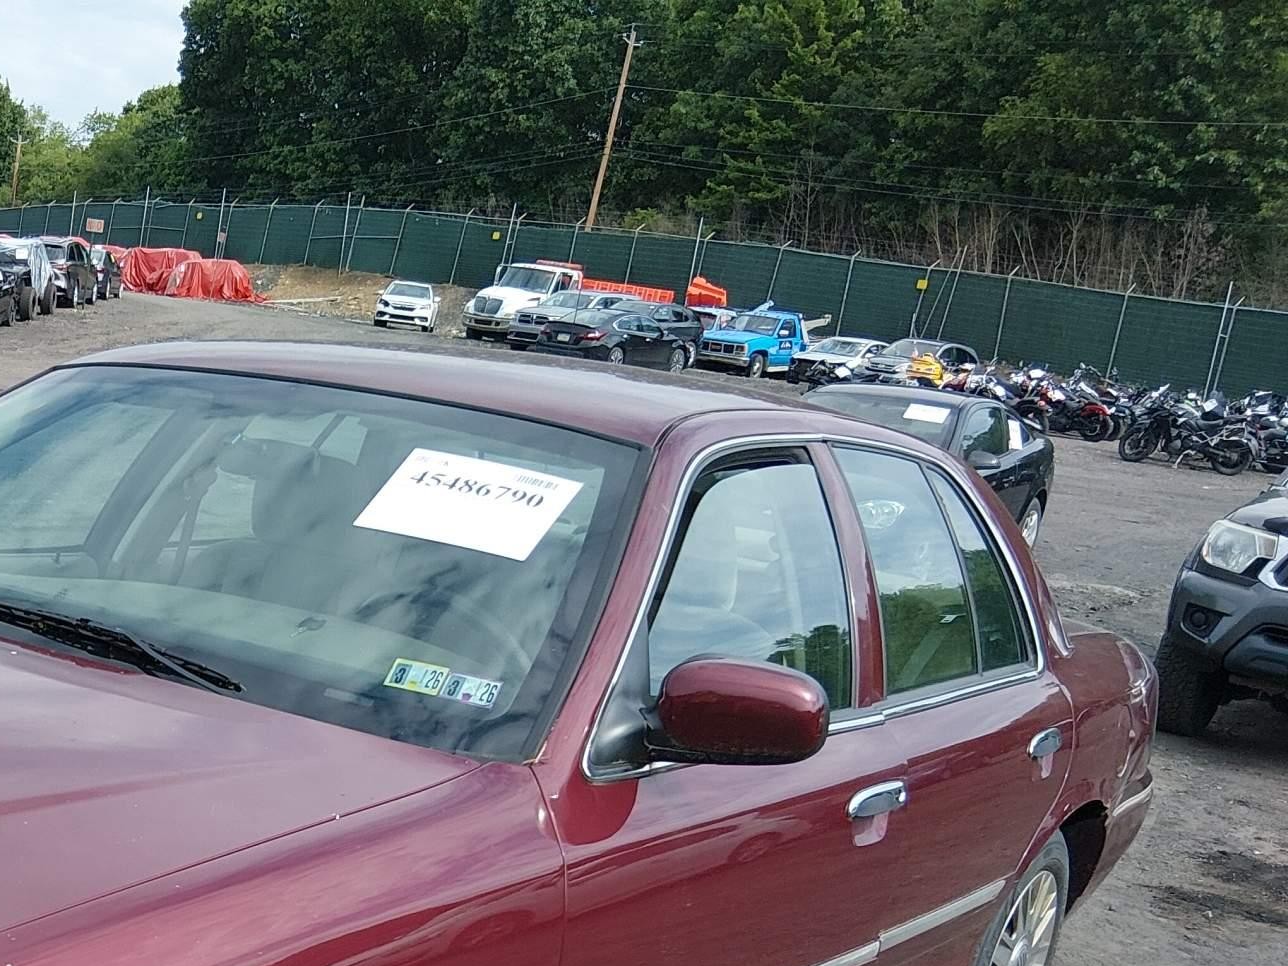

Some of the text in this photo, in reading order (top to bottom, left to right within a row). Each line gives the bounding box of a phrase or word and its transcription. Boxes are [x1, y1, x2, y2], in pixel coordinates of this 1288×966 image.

[410, 470, 545, 508] 45486790
[394, 667, 444, 690] 3 26
[447, 679, 499, 704] 3 26
